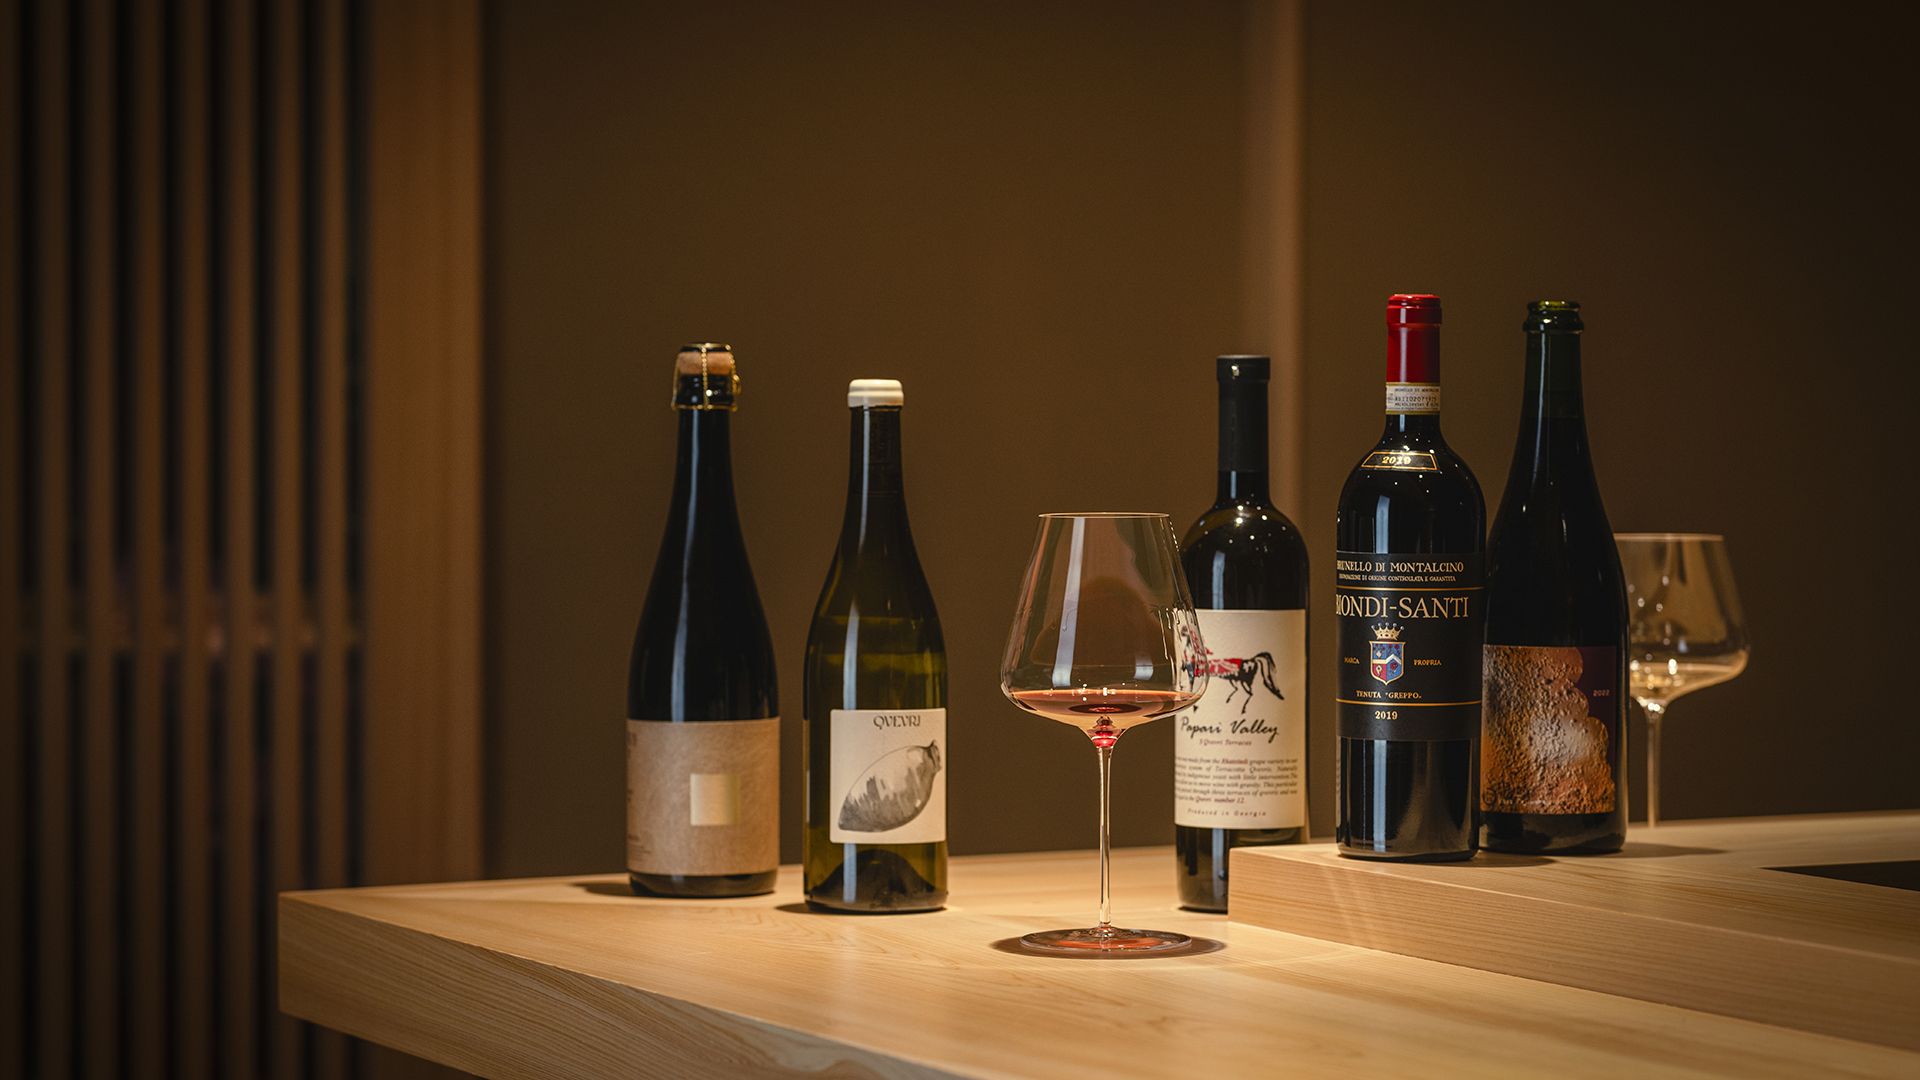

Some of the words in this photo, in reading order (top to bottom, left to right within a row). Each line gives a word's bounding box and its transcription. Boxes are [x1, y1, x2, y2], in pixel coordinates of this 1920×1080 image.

[1381, 456, 1412, 465] 2019
[1375, 562, 1386, 572] DI
[1390, 562, 1464, 573] MONTALCINO
[1413, 659, 1442, 667] PROPRIA
[1355, 690, 1381, 699] TENUTA
[1375, 710, 1398, 721] 2019
[1181, 716, 1221, 738] Papari
[1229, 718, 1280, 744] Valley
[1251, 788, 1259, 797] of
[1187, 807, 1218, 816] Produced
[1233, 810, 1267, 818] Georgia
